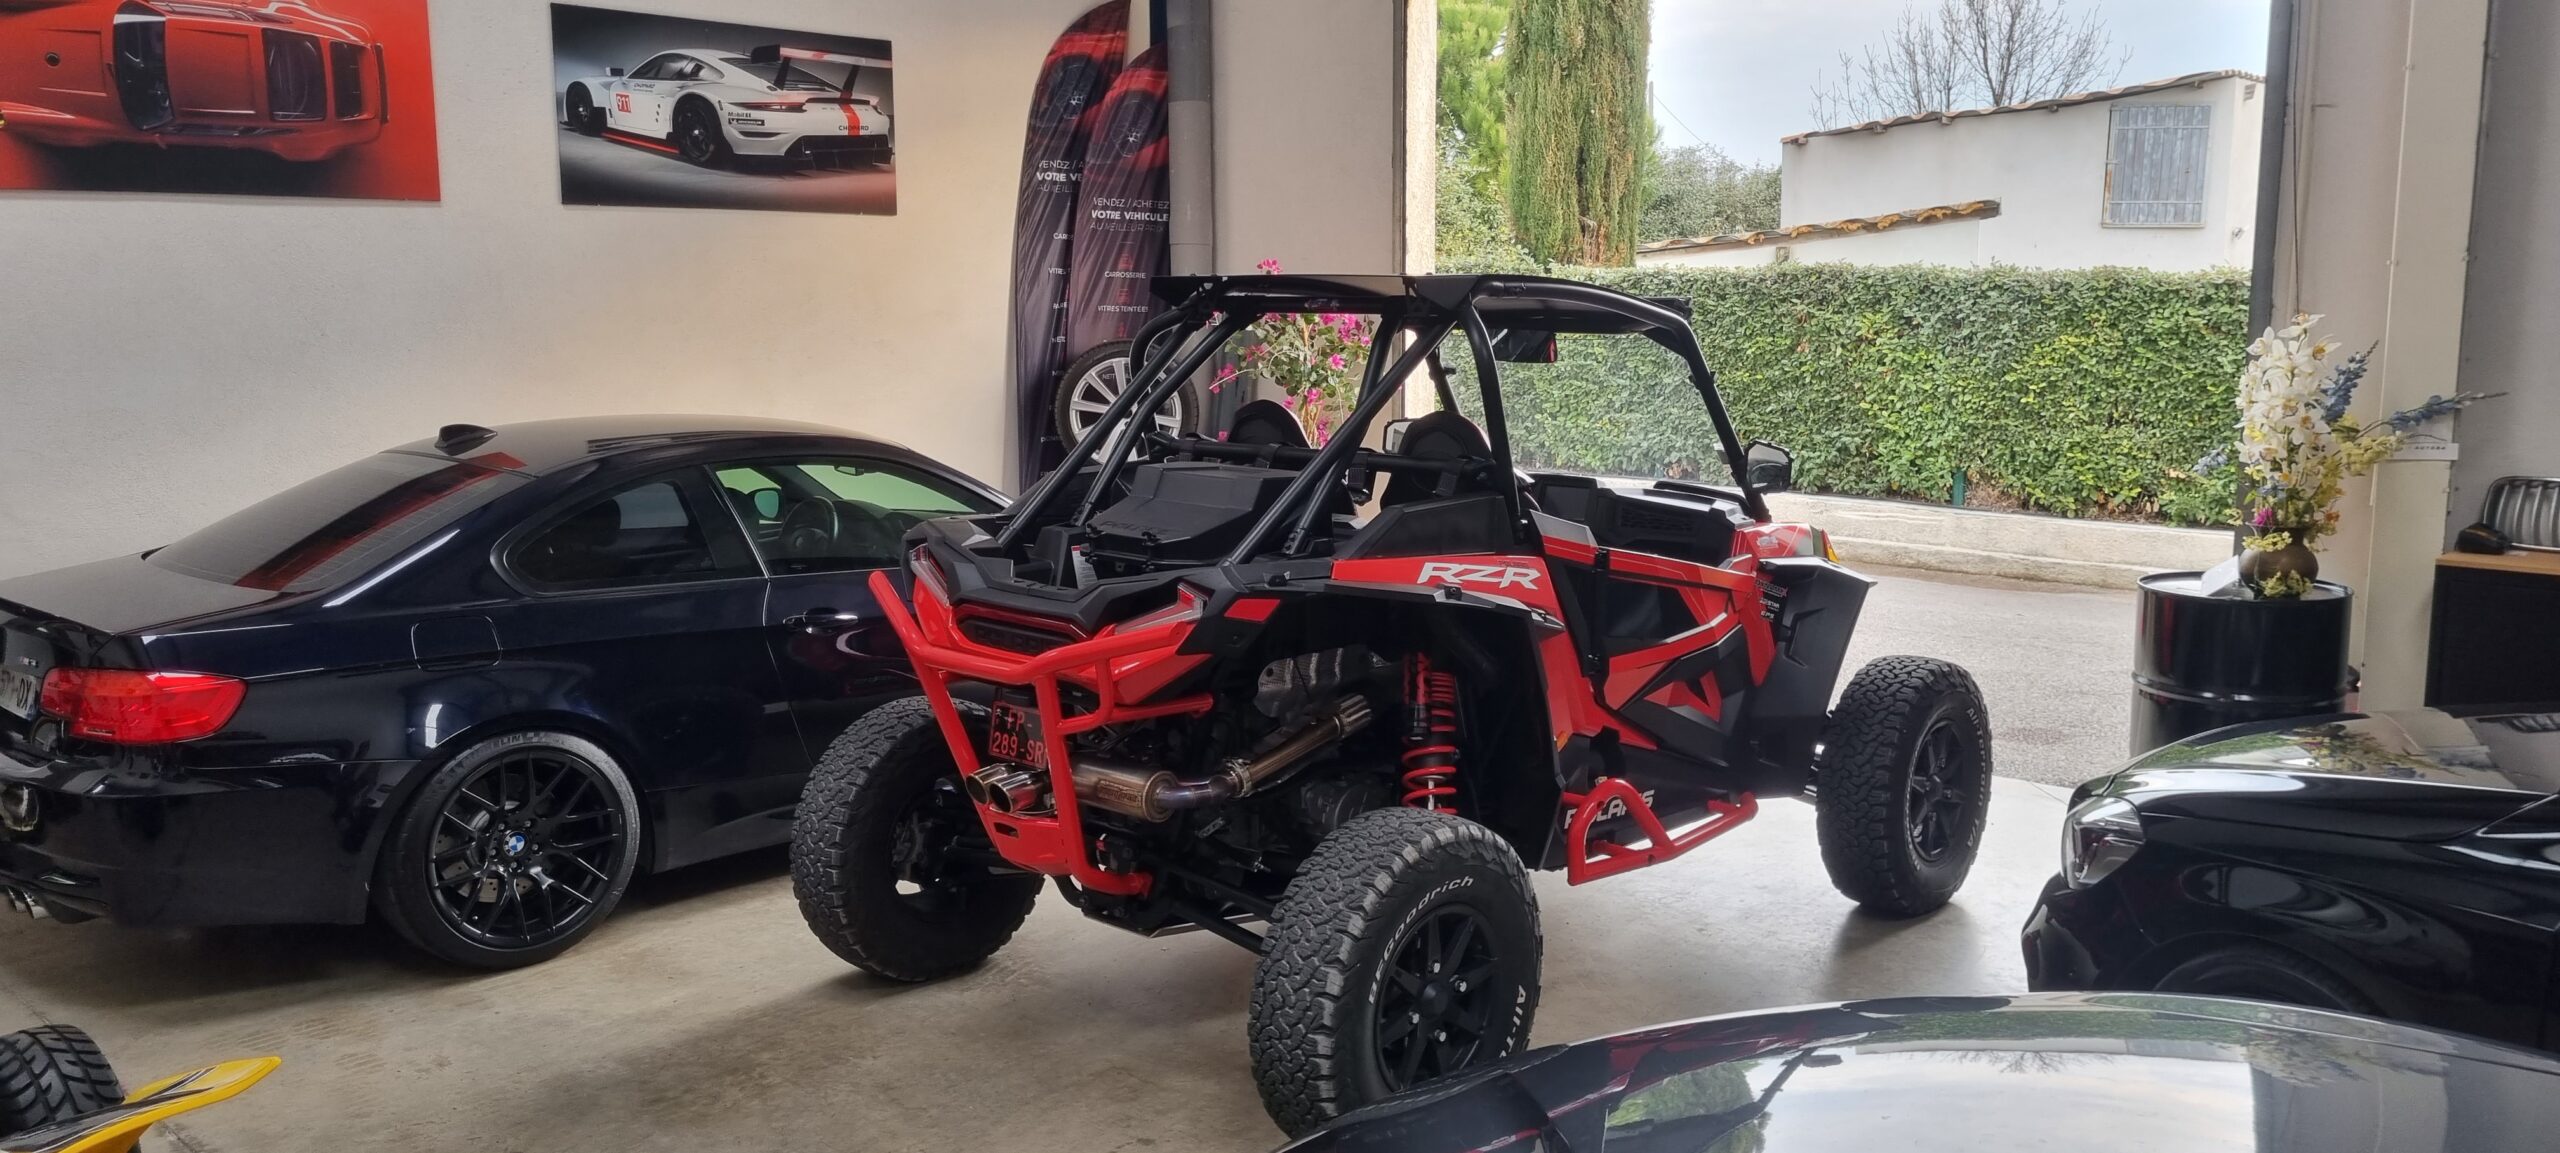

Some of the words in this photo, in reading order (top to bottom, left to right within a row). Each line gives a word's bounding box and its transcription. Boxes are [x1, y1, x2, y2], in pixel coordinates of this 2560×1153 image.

[616, 95, 631, 112] 911
[1036, 172, 1067, 182] VOTRE
[1093, 197, 1125, 208] VENDEZ
[1091, 209, 1121, 220] VOTRE
[1104, 270, 1147, 279] CARROSSERIE
[1097, 305, 1120, 313] VITRES
[1416, 562, 1542, 591] RZR
[1564, 789, 1655, 830] PLAS
[1368, 875, 1475, 1005] BFGoodrich
